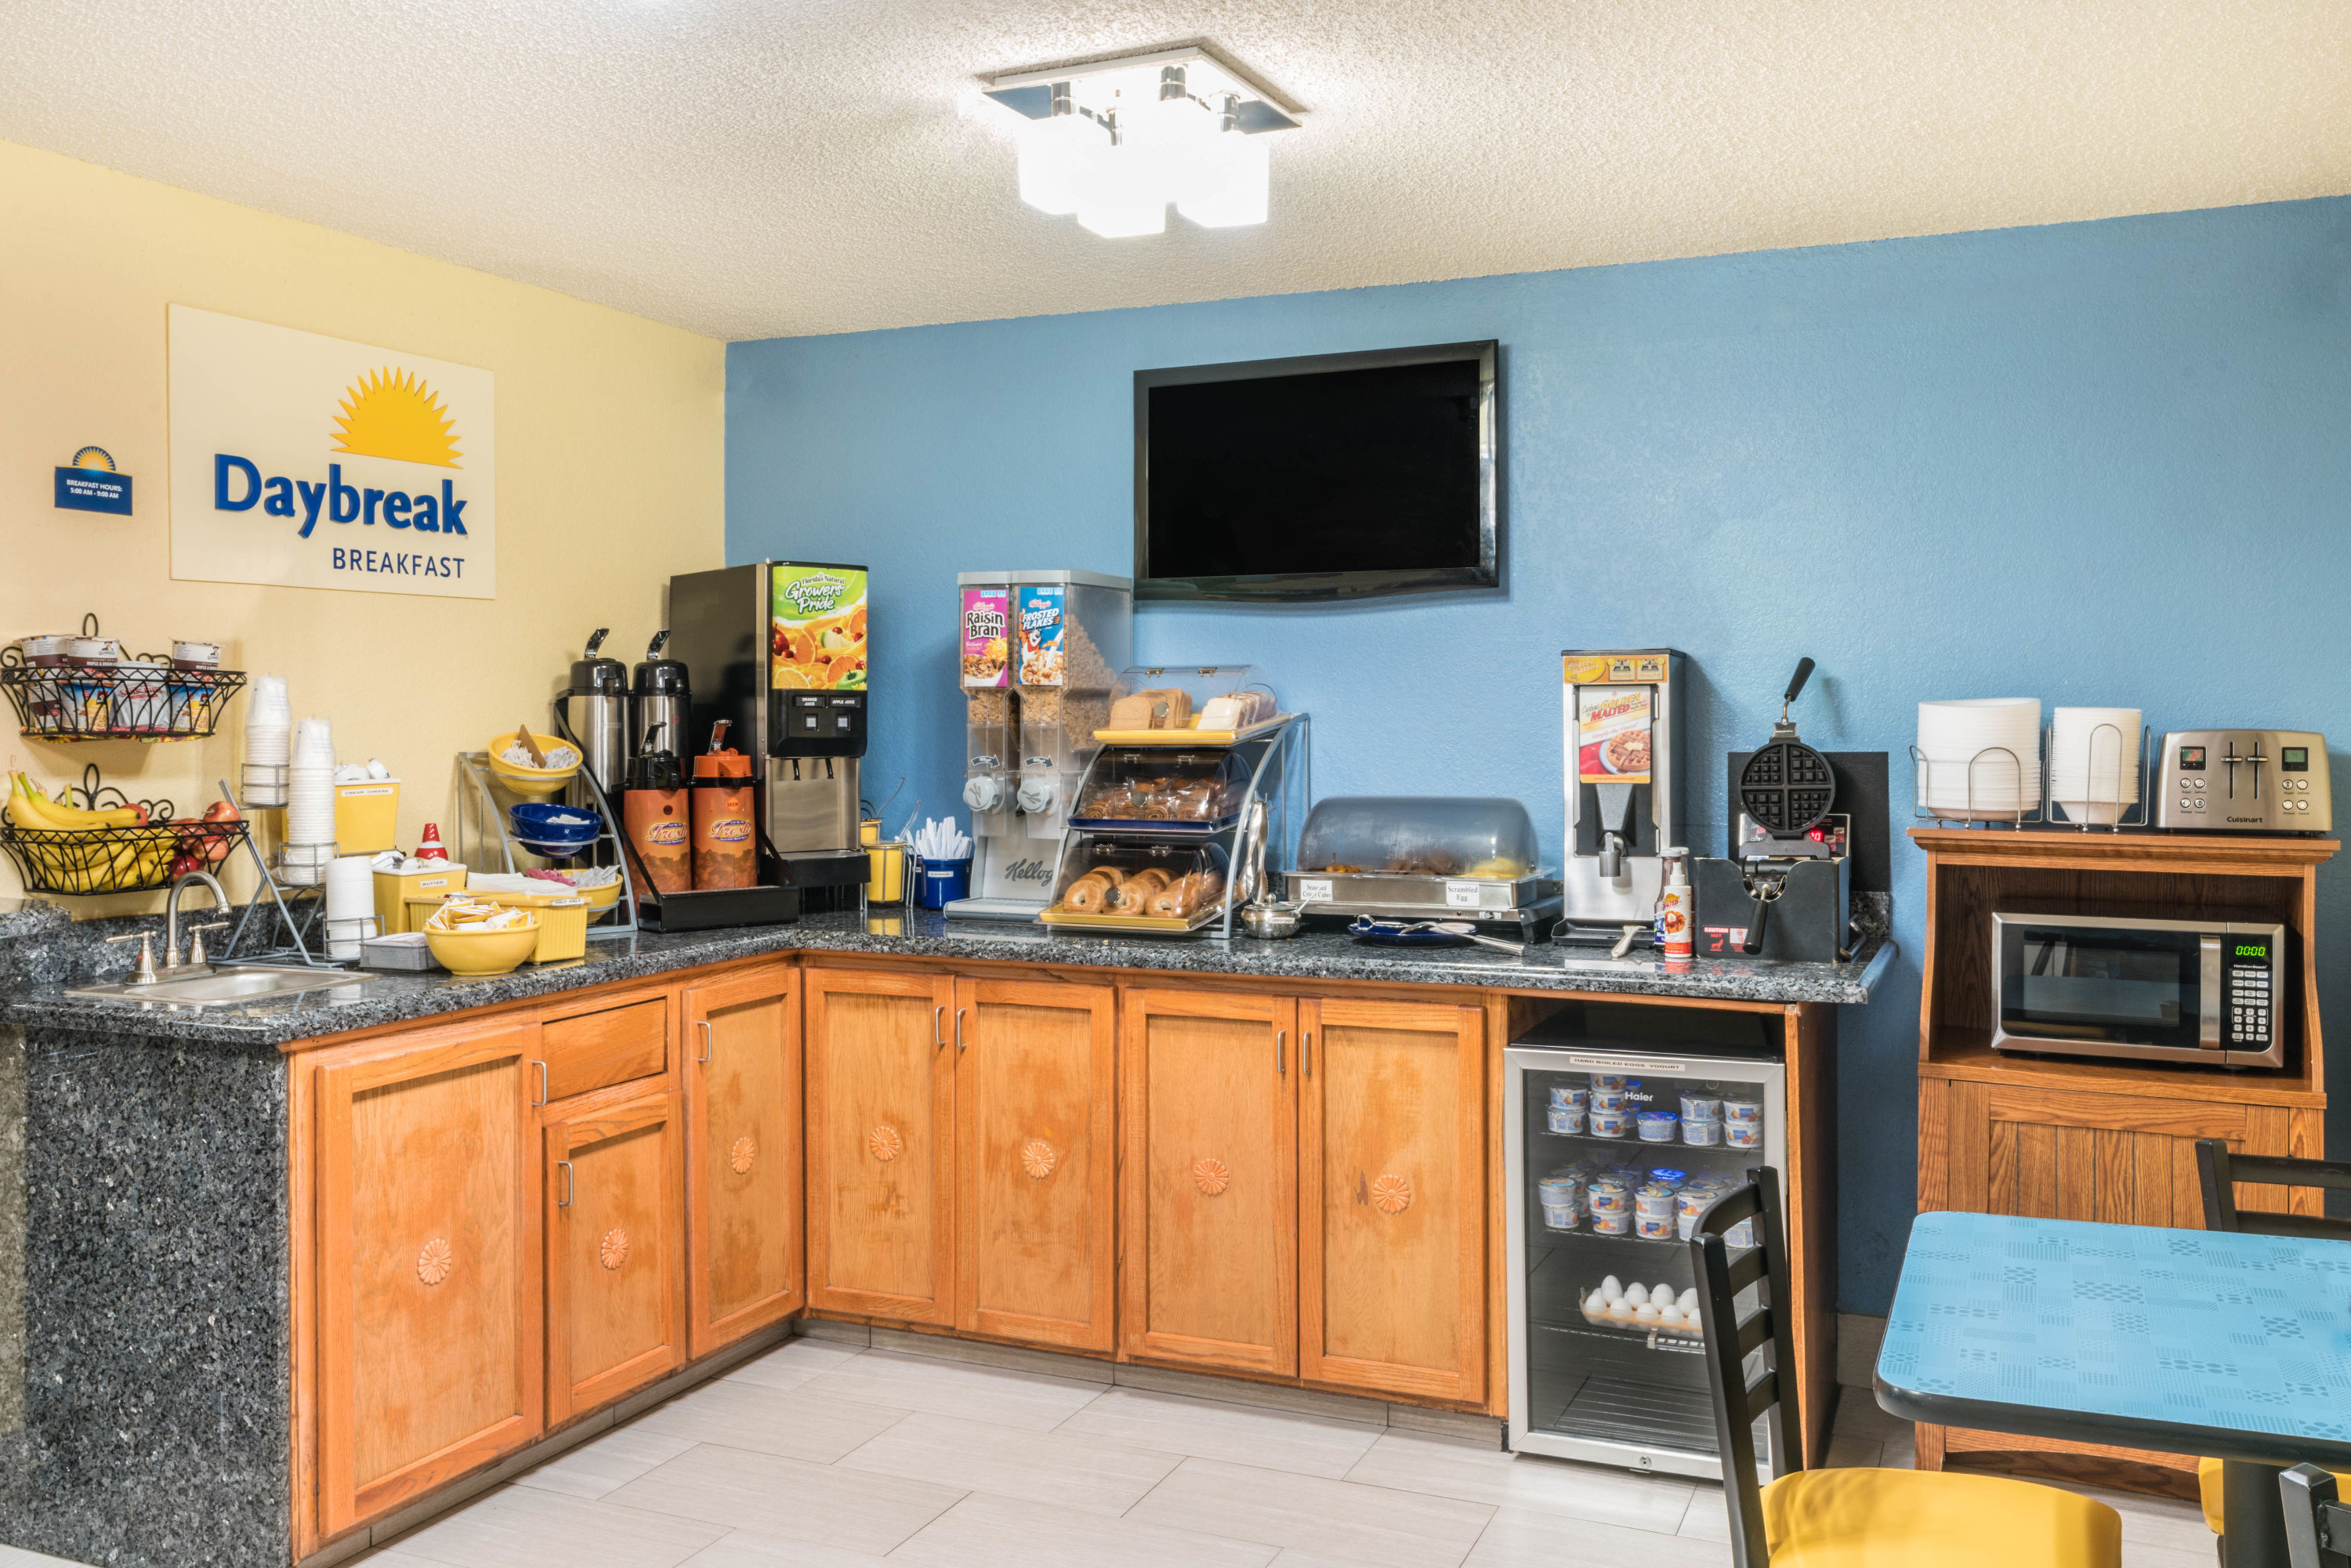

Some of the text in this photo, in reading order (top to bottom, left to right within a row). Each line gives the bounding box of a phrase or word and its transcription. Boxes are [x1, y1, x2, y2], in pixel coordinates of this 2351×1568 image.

[66, 479, 122, 492] BREAKFAST HOURS:
[215, 454, 469, 539] Daybreak
[332, 547, 465, 578] BREAKFAST
[824, 574, 845, 585] Natural
[796, 596, 835, 615] Pride
[965, 610, 1005, 628] Raisin
[1022, 607, 1060, 624] FROSTED
[1022, 617, 1055, 631] FLAKES
[969, 625, 1001, 639] Bran
[1601, 693, 1641, 710] GOLDEN
[1591, 704, 1631, 722] MALTED
[646, 822, 688, 842] Fresh
[708, 820, 752, 838] Fresh
[1005, 858, 1054, 887] Kellog
[2235, 945, 2266, 957] 00:00
[1625, 1091, 1654, 1102] Haier
